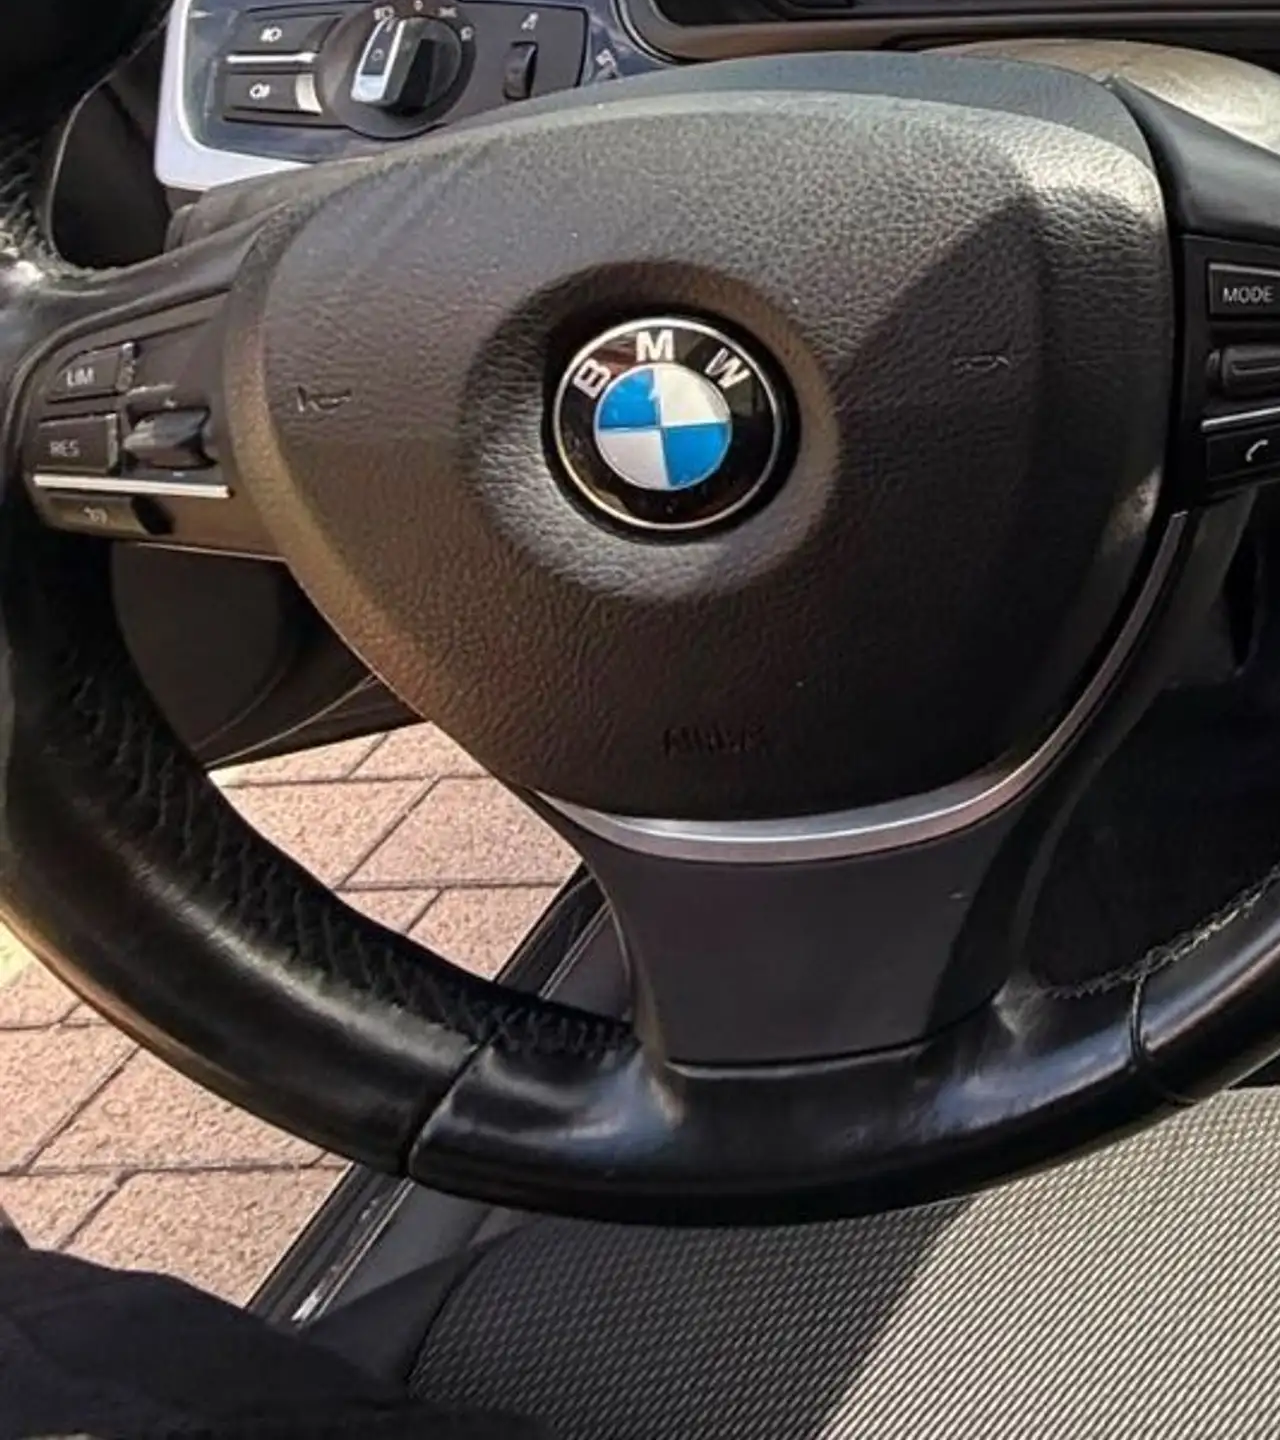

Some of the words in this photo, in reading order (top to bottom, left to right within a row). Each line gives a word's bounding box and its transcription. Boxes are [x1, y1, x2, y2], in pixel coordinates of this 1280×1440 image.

[1222, 286, 1274, 304] MODE
[571, 329, 751, 400] BMW
[66, 367, 95, 388] LIM
[50, 440, 80, 458] RES
